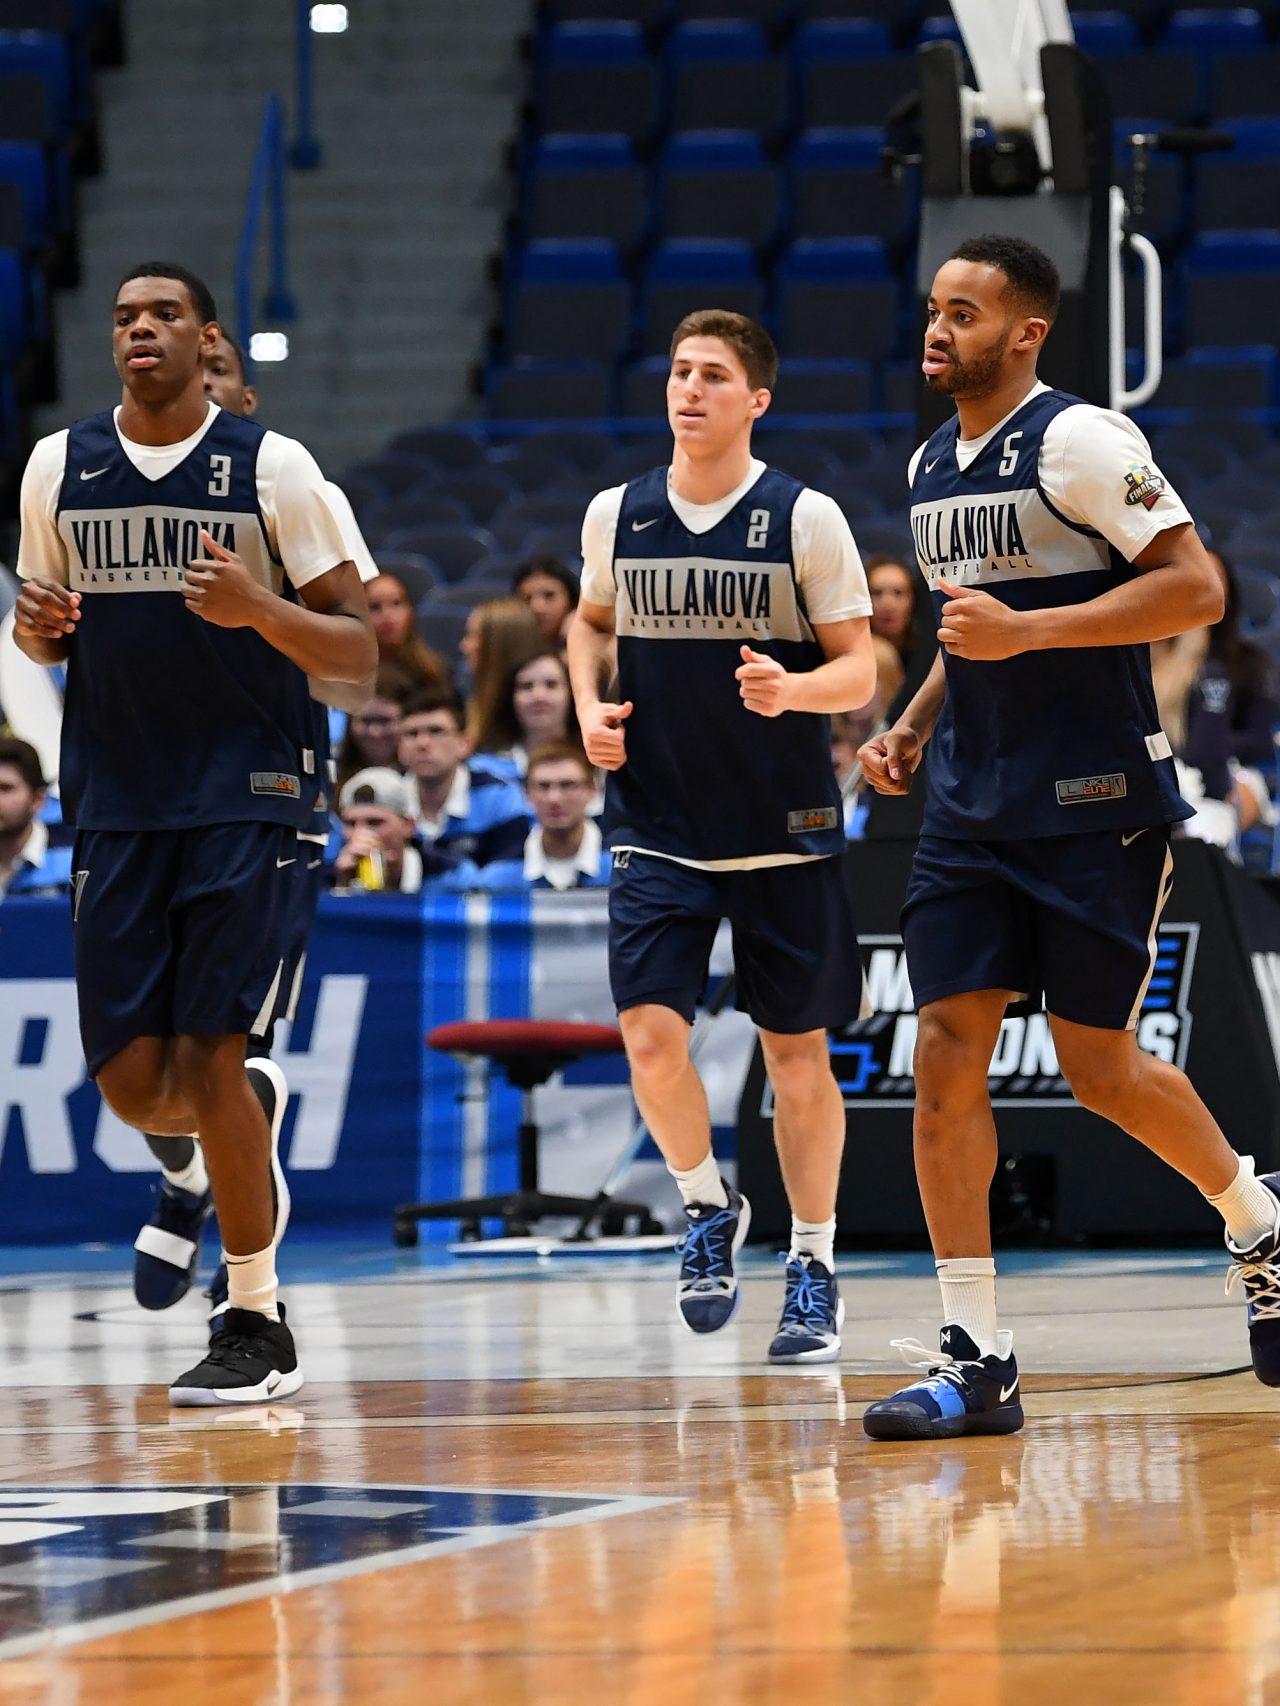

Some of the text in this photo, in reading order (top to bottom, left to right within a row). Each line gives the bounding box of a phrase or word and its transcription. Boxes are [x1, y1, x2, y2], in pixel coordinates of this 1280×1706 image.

[207, 454, 232, 497] 3
[998, 431, 1024, 476] 5
[746, 508, 771, 549] 2
[913, 503, 1029, 566] VILLANOVA
[624, 568, 771, 618] VILLANOVA
[1083, 777, 1109, 787] NIKE
